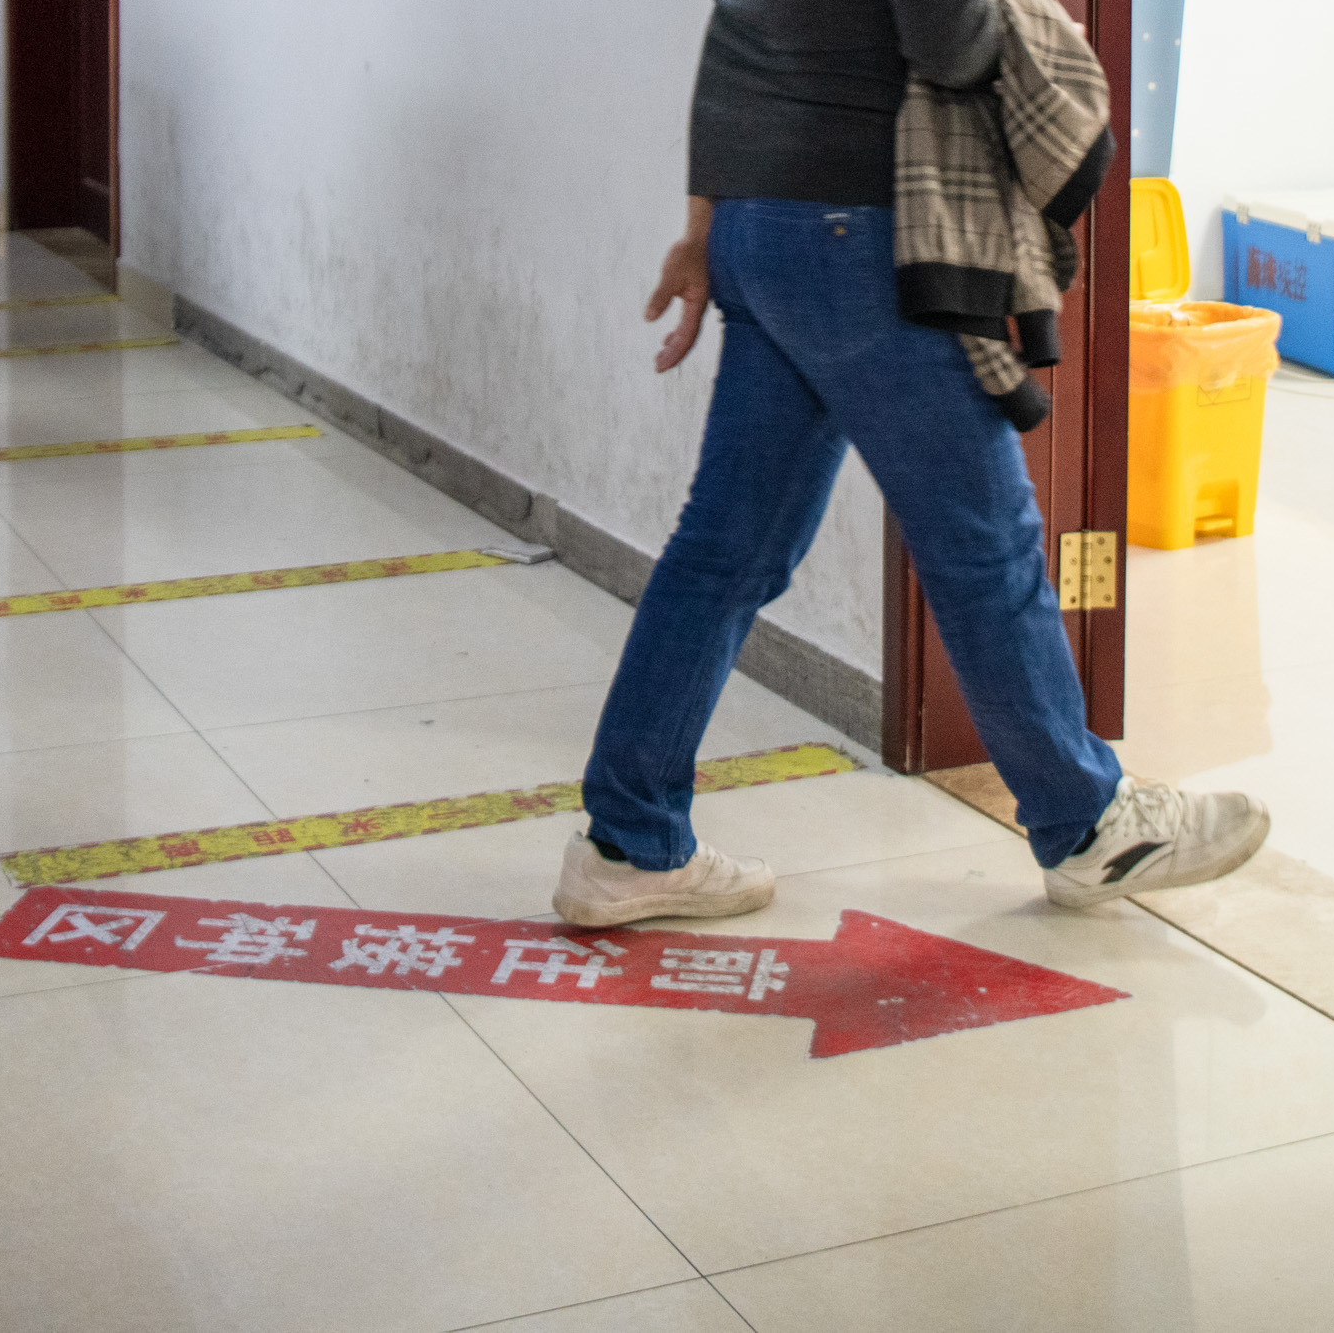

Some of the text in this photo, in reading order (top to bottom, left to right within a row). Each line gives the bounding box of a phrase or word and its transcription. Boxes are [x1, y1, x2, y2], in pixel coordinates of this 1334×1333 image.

[20, 902, 792, 1003] 前往接种区
